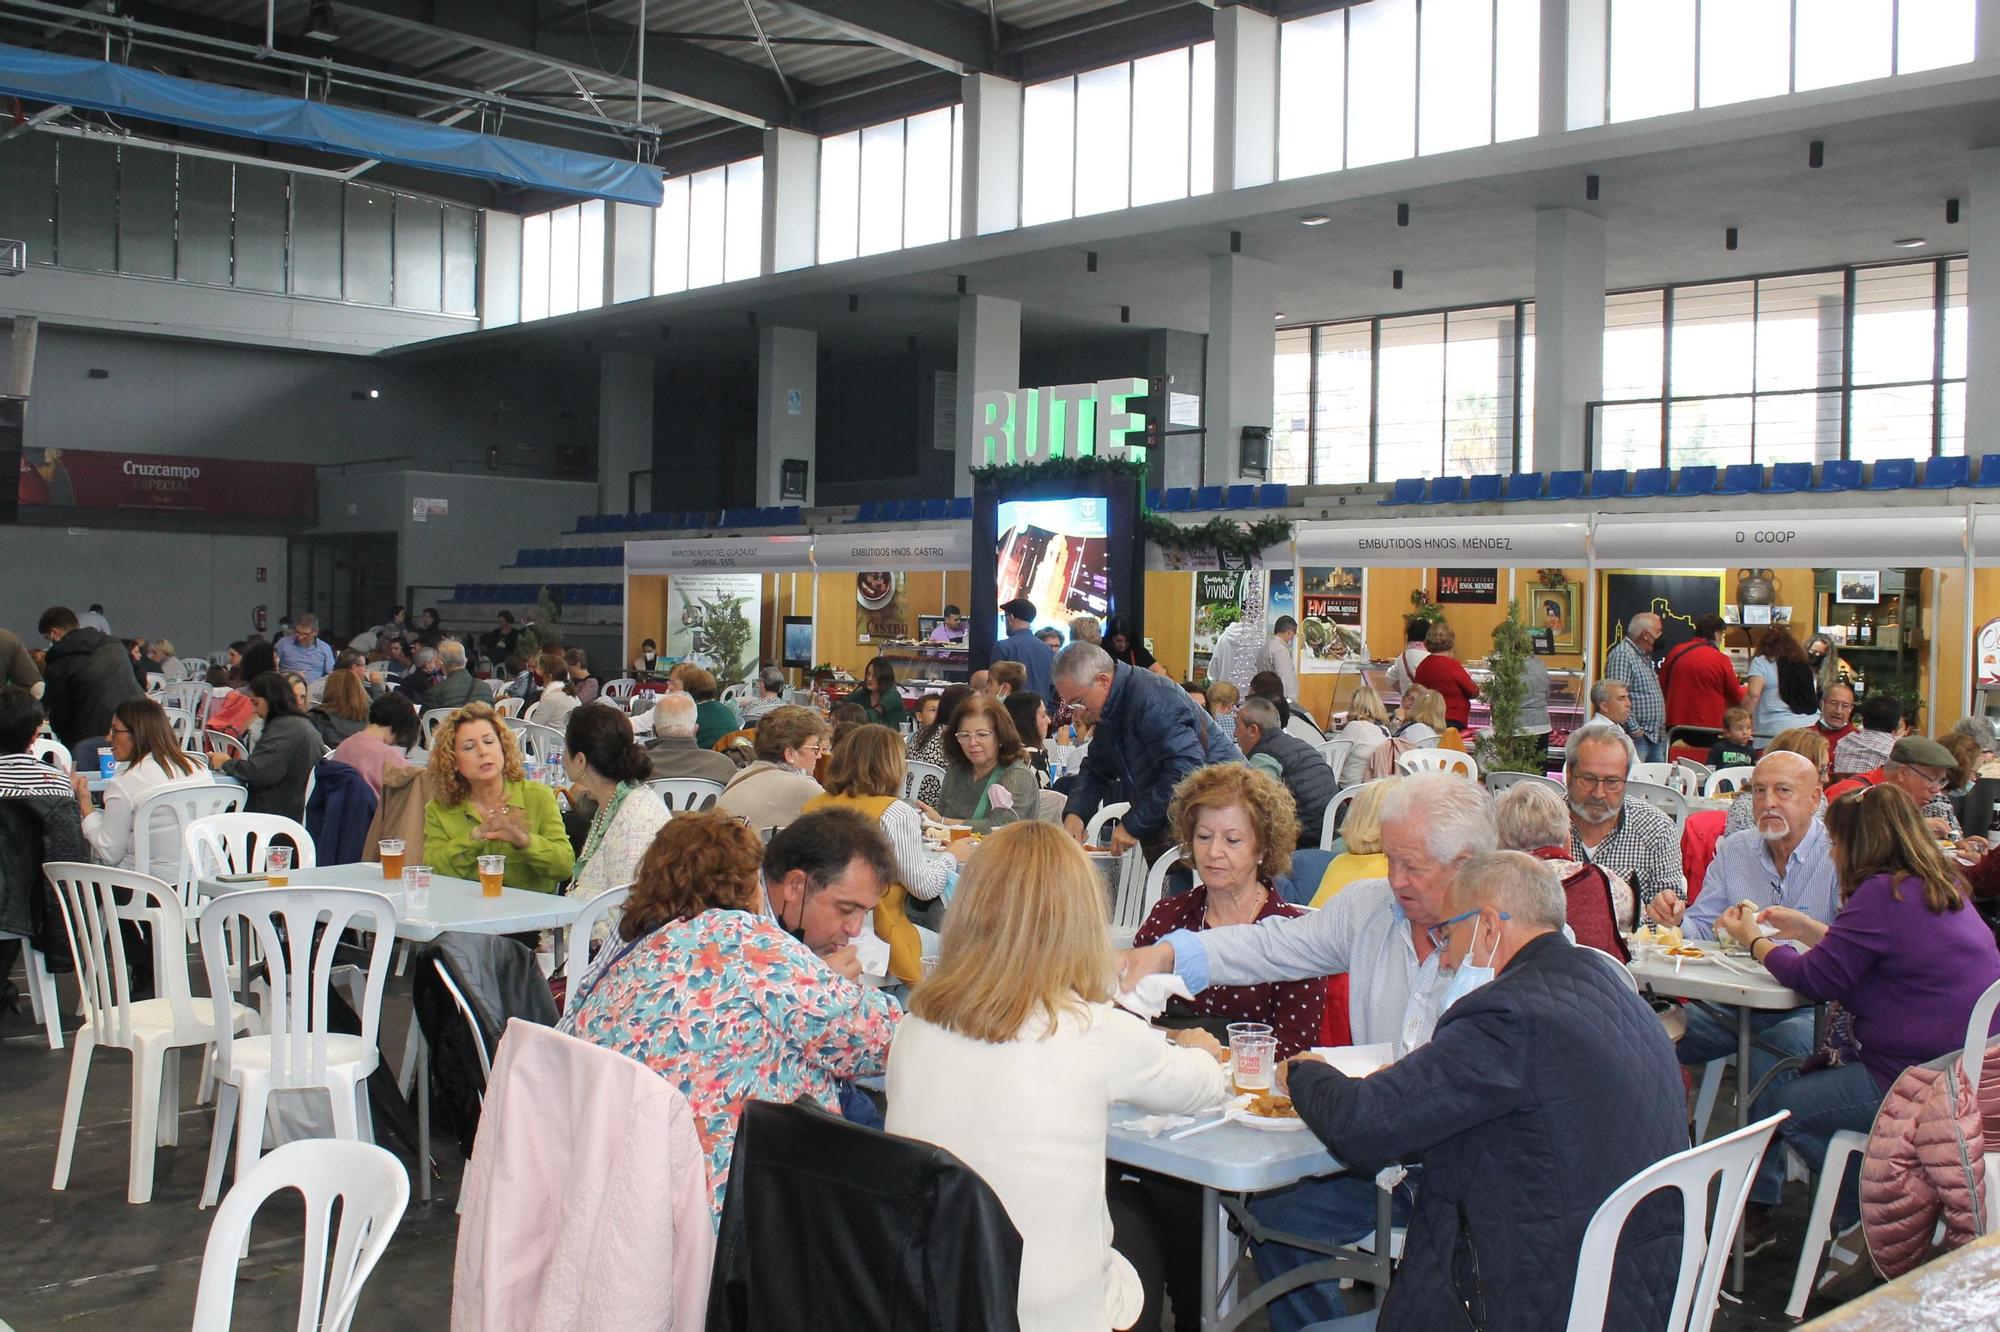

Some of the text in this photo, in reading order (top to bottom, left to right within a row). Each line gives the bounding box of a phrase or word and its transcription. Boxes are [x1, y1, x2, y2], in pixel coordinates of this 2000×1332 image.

[972, 377, 1149, 466] RUTE
[123, 460, 200, 480] Cruzcampo
[1358, 535, 1513, 550] EMBUTIDOS HNOS. MÉNDEZ
[1735, 531, 1796, 543] D COOP
[851, 547, 890, 557] EMBUTIDOS
[914, 547, 944, 557] CASTRO
[1205, 583, 1235, 600] VIVIRLO
[866, 618, 908, 634] CASTRO
